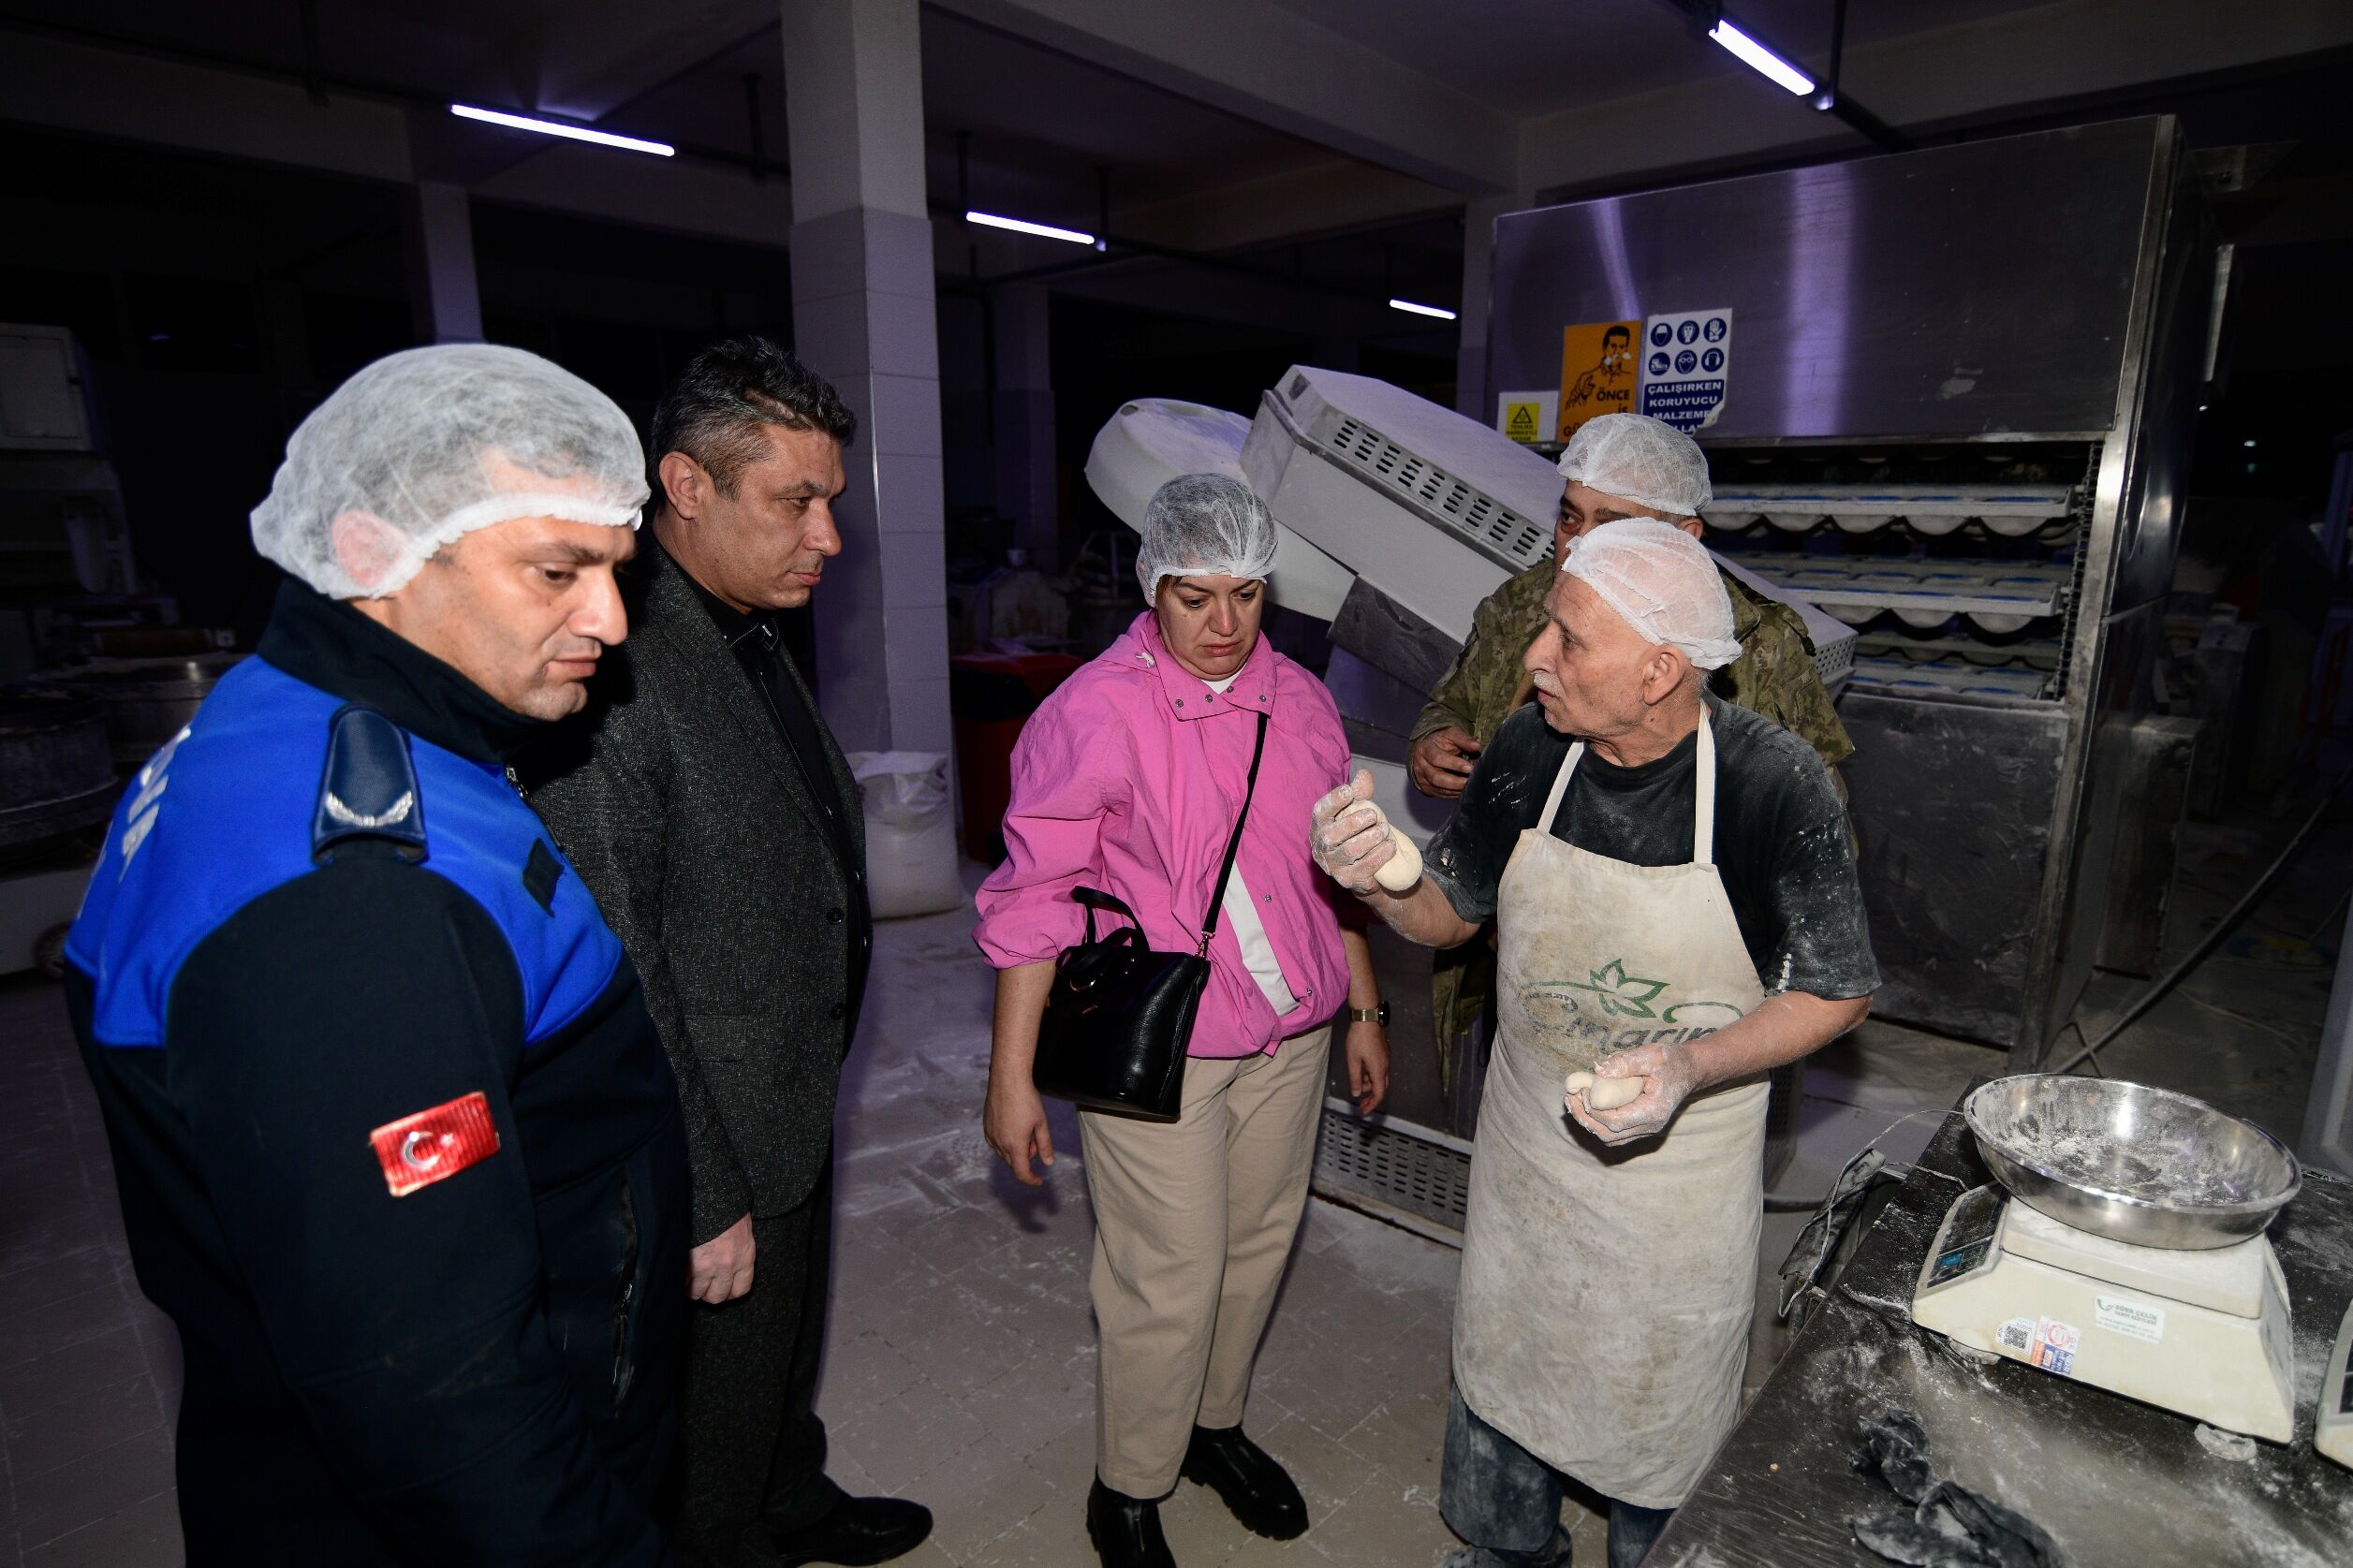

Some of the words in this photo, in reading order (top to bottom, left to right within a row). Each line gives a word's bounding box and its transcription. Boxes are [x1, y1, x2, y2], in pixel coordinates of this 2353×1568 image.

[1596, 388, 1630, 402] ÖNCE
[1648, 381, 1722, 395] ÇALIŞIRKEN
[1649, 395, 1718, 407] KORUYUCU
